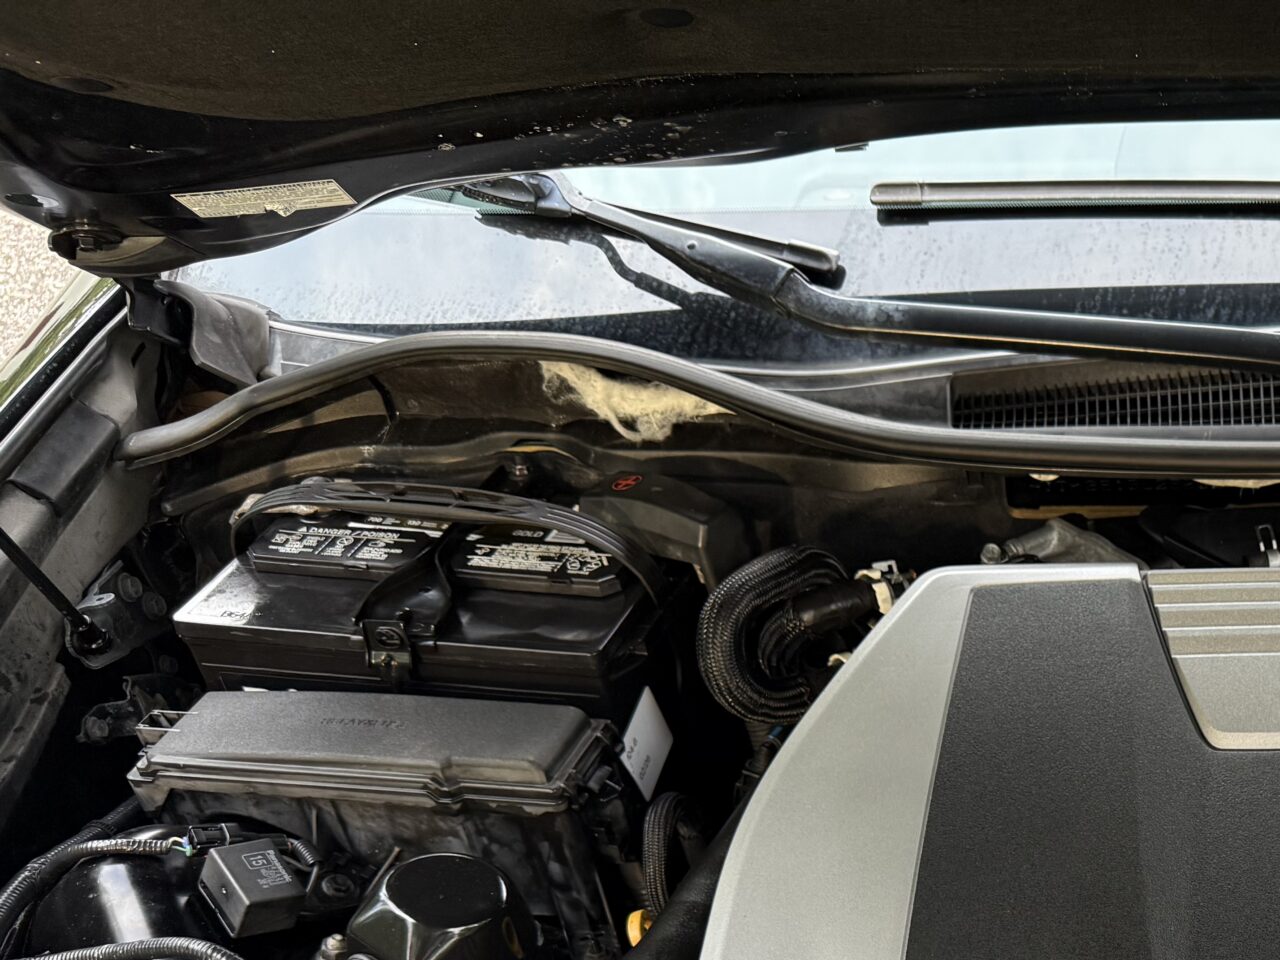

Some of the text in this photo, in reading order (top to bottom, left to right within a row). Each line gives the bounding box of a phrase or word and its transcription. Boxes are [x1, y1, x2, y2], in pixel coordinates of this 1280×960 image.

[309, 527, 352, 536] DANGER
[360, 530, 401, 539] POISON
[512, 529, 545, 539] GOLD
[249, 854, 268, 867] 15
[266, 849, 293, 883] Panasonic
